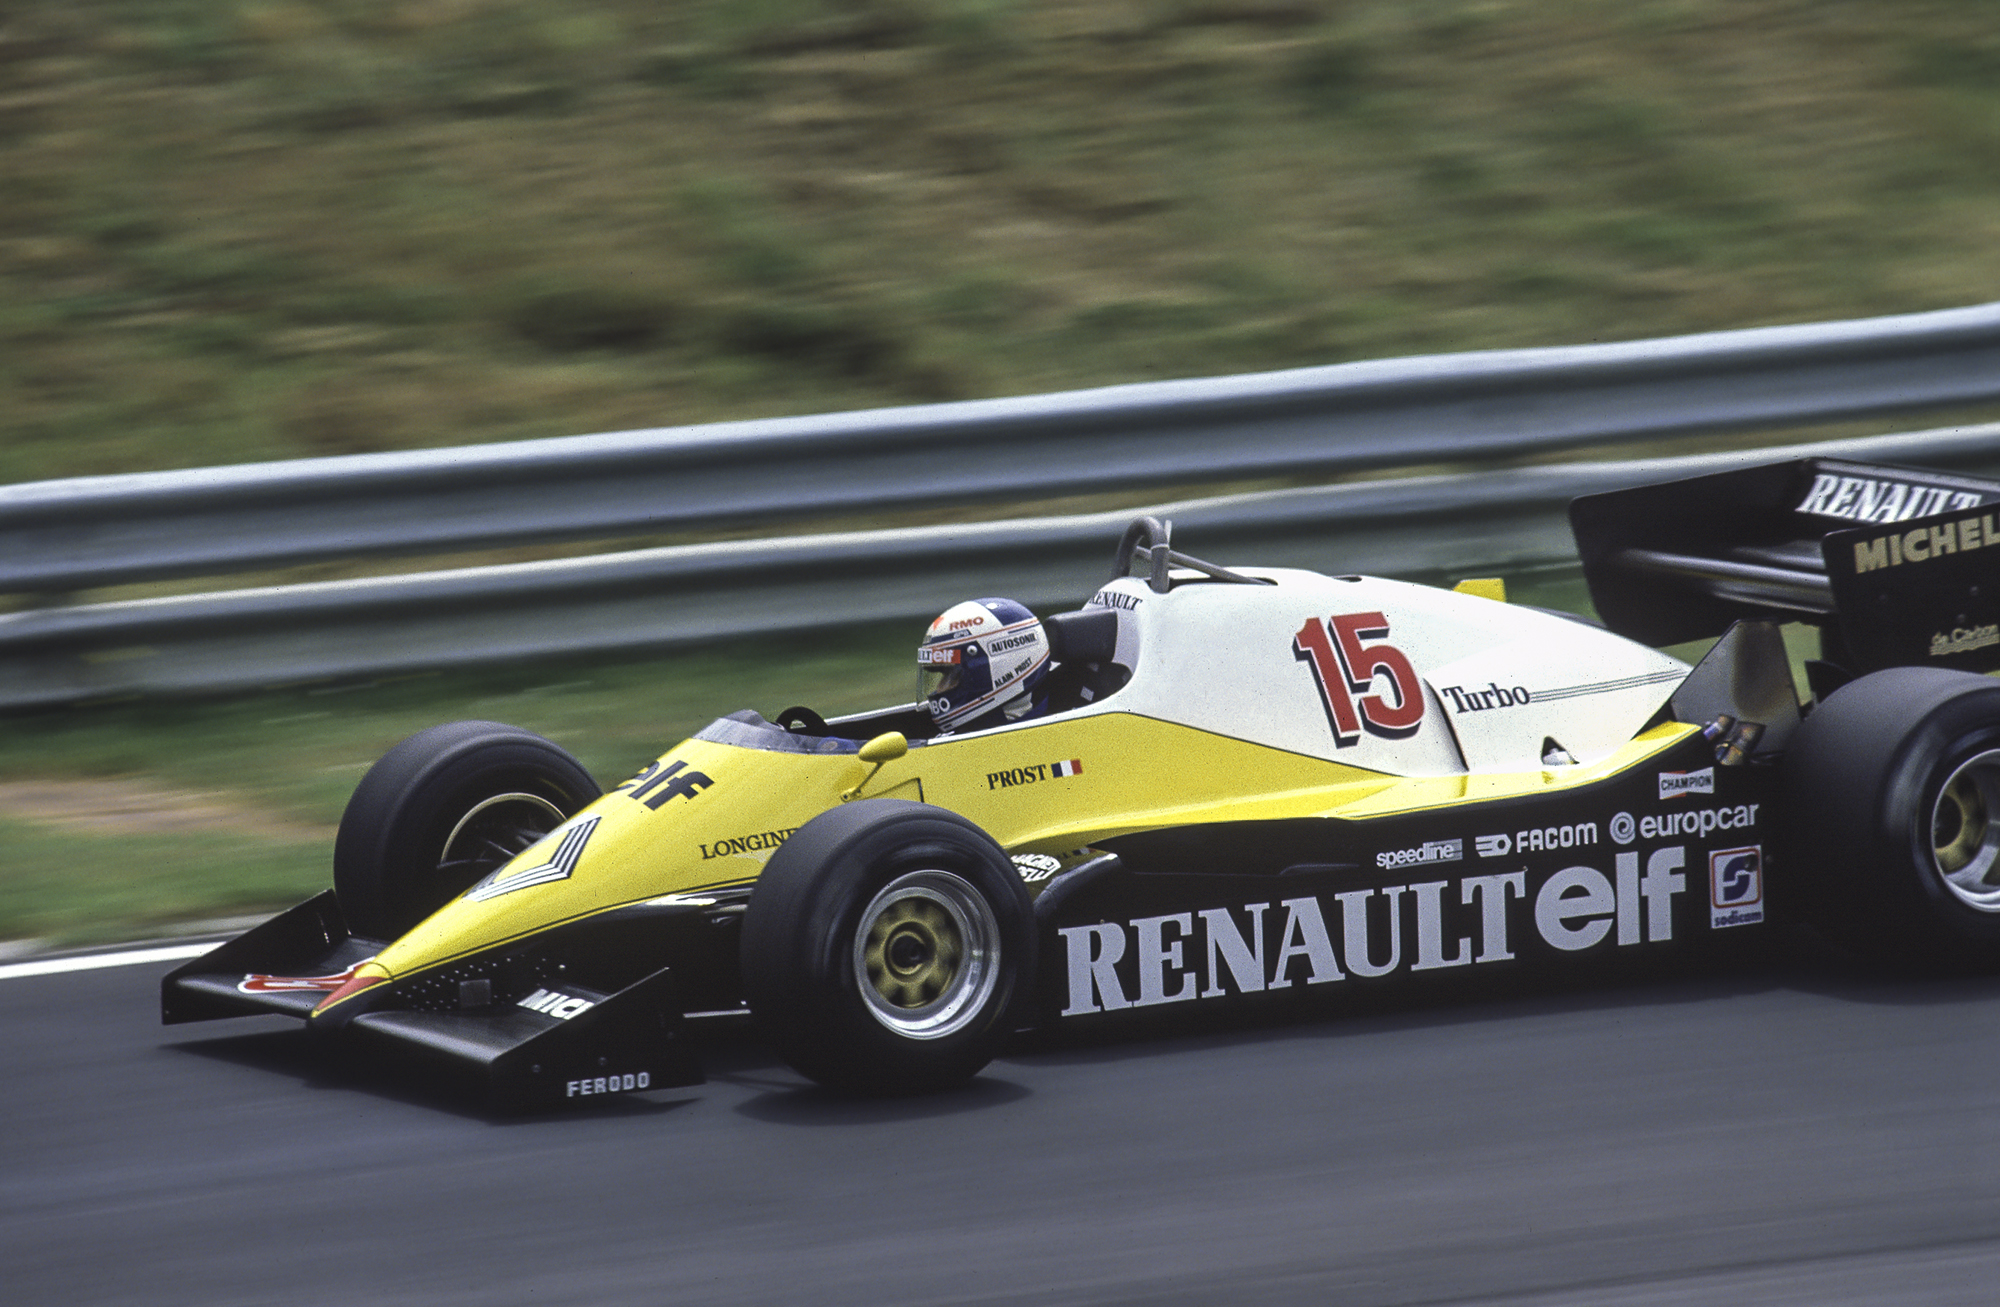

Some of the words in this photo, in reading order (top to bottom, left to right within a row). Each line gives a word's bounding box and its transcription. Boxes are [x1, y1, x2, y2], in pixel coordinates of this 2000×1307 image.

[949, 616, 984, 631] RMO
[994, 671, 1014, 688] ALAIN
[1014, 657, 1032, 676] PROST
[1292, 611, 1425, 749] 15
[1441, 683, 1530, 713] Turbo
[986, 764, 1047, 791] PROST
[1661, 775, 1711, 791] CHAMPION
[1639, 804, 1760, 838] europcar
[1376, 841, 1454, 870] speedline
[1058, 870, 1527, 1017] RENAULT
[1535, 846, 1686, 951] elf
[566, 1072, 649, 1097] FERODO
